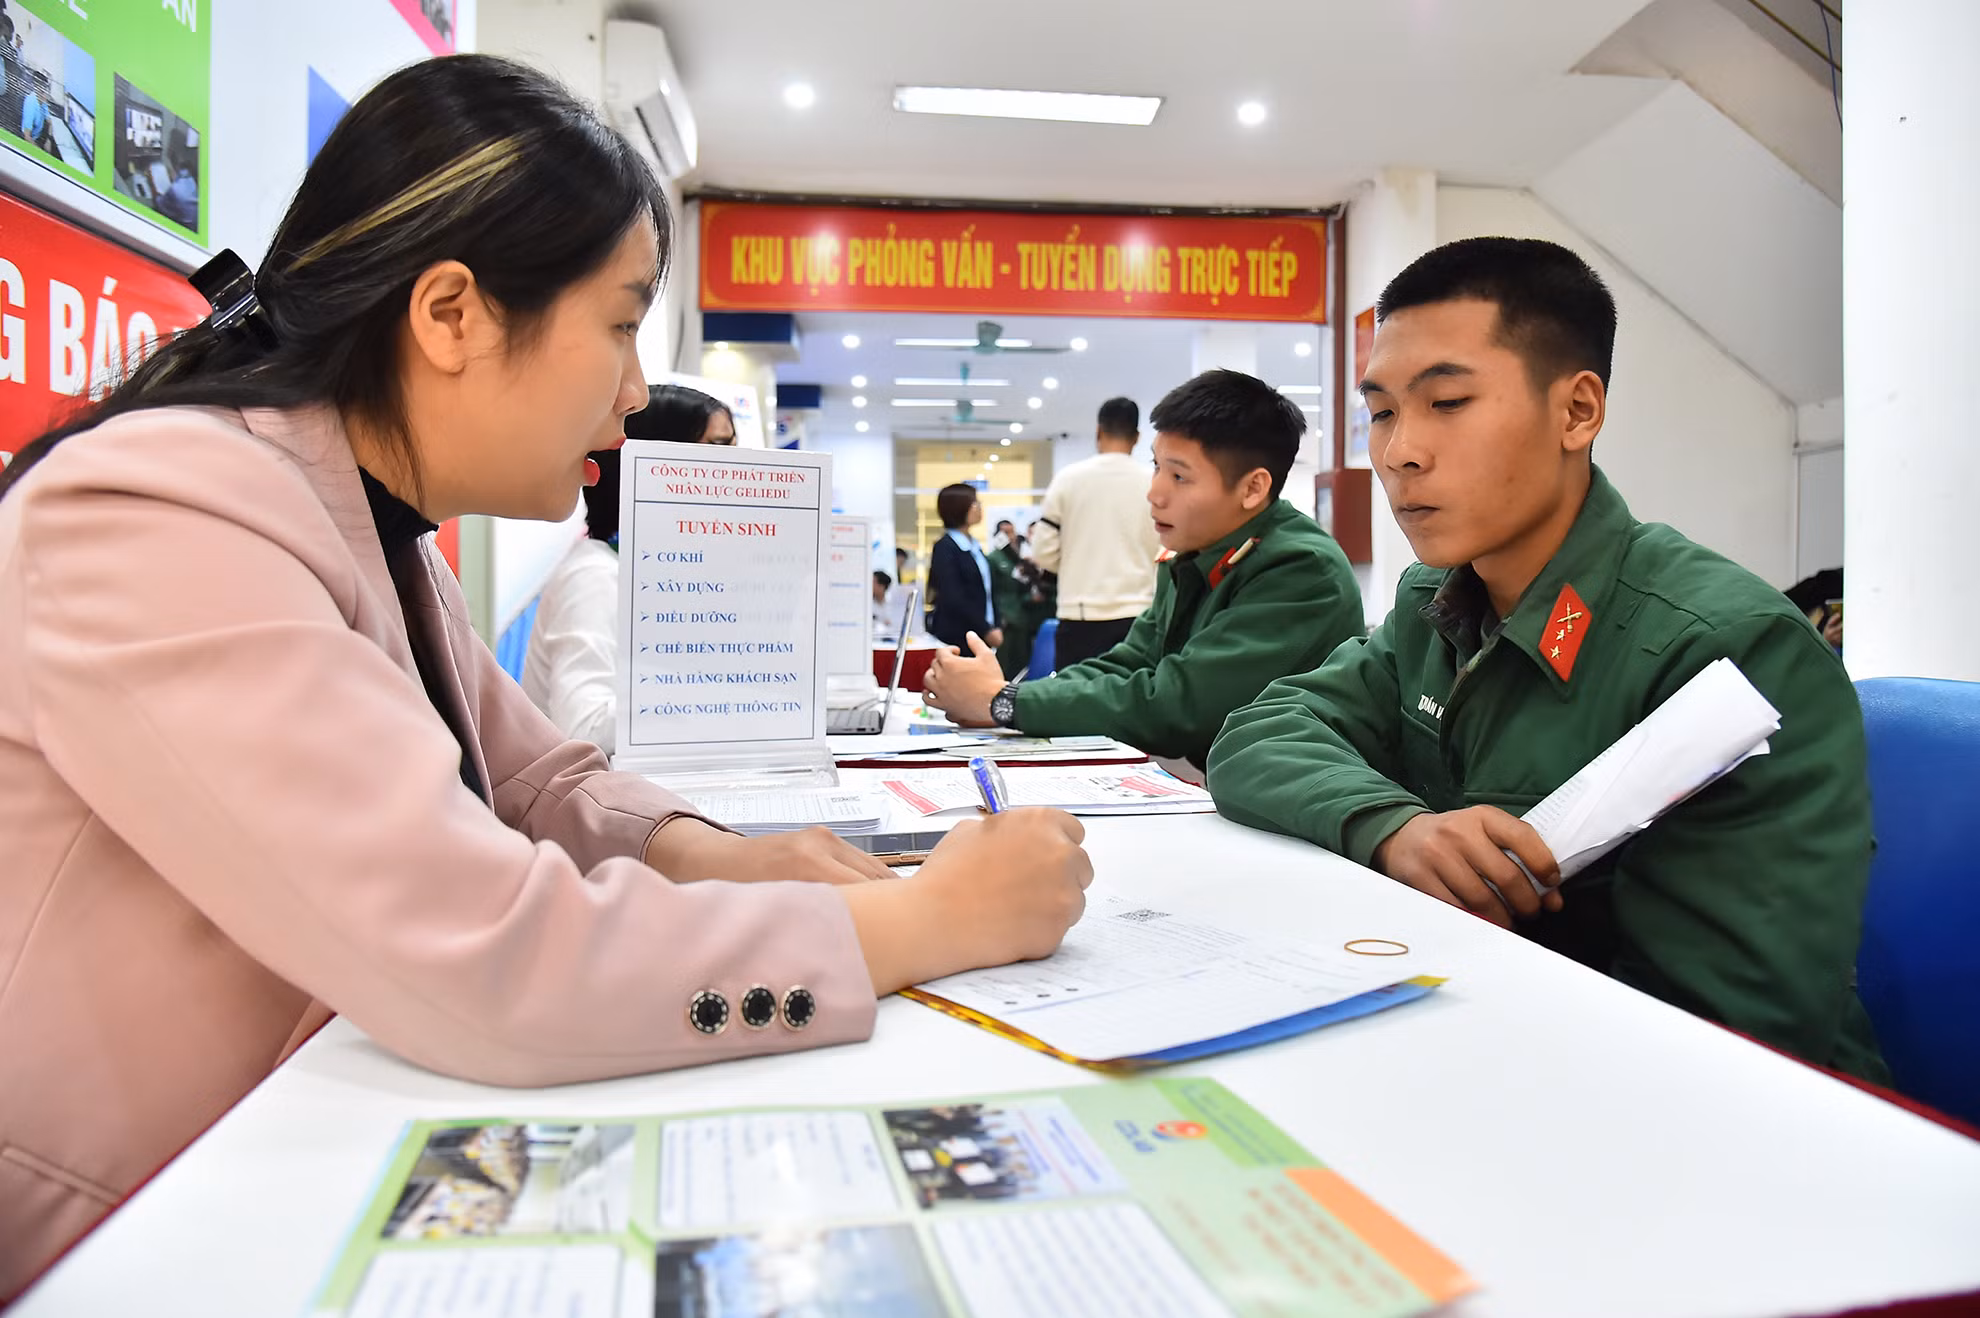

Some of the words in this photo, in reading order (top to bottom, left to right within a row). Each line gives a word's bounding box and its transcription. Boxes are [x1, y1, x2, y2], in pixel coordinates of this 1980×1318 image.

[731, 236, 784, 284] KHU
[790, 236, 841, 296] VỰC
[847, 222, 936, 288] PHỎNG
[941, 223, 994, 289] VẤN
[1016, 224, 1097, 292] TUYỂN
[1102, 244, 1172, 304] DỤNG
[1177, 243, 1240, 305] TRỰC
[1245, 235, 1299, 298] TIẾP
[49, 275, 159, 403] BÁO
[650, 464, 689, 478] CÔNG
[692, 468, 709, 479] TY
[711, 469, 729, 480] CP
[731, 467, 766, 482] PHÁT
[666, 482, 703, 495] NHÂN
[706, 485, 733, 498] LỰC
[735, 487, 791, 499] GELIEDU
[676, 519, 734, 535] TUYỂN
[737, 523, 777, 537] SINH
[657, 551, 677, 563] CƠ
[680, 550, 704, 563] KHÍ
[656, 579, 684, 593] XÂY
[687, 582, 725, 595] DỰNG
[656, 611, 687, 623] ĐIỀU
[691, 611, 737, 624] DƯỠNG
[655, 641, 683, 654] CHẾ
[686, 641, 716, 653] BIẾN
[718, 642, 756, 655] THỰC
[655, 671, 683, 684] NHÀ
[686, 671, 723, 684] HÀNG
[726, 669, 771, 684] KHÁCH
[773, 672, 798, 685] SẠN
[654, 702, 692, 715] CÔNG
[695, 703, 732, 716] NGHỆ
[734, 700, 778, 713] THÔNG
[780, 702, 801, 712] TIN
